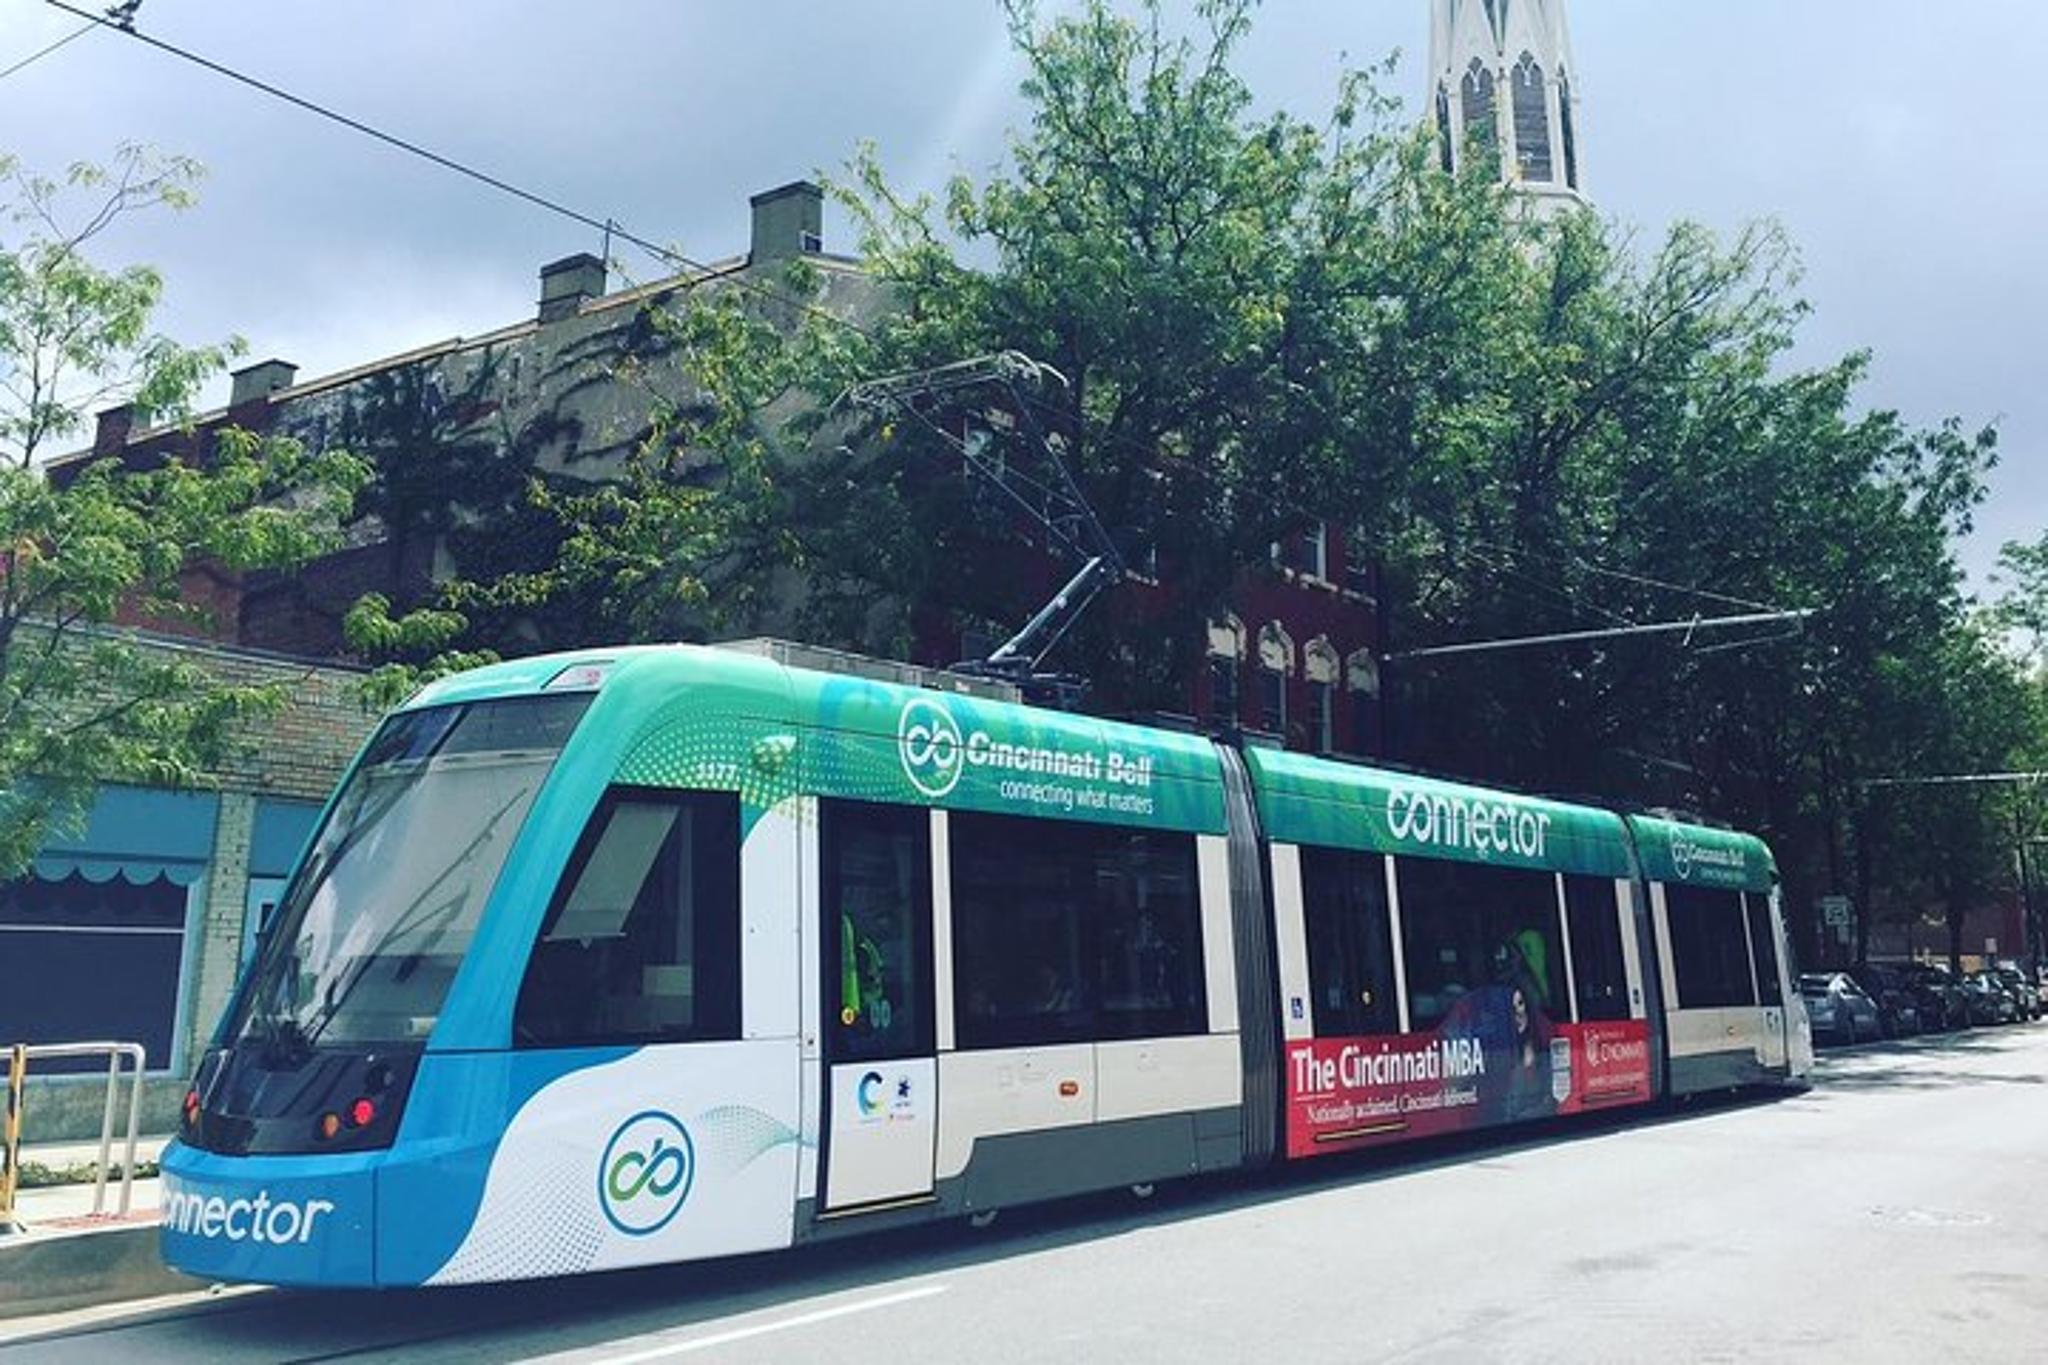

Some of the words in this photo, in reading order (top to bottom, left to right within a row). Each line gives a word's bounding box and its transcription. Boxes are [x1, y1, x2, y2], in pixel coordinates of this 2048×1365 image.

[966, 731, 1101, 778] Cincinnati
[1107, 752, 1152, 786] Bell
[1000, 778, 1073, 812] connecting
[1077, 783, 1108, 807] what
[1109, 789, 1154, 814] matters
[1293, 1046, 1335, 1092] The
[1339, 1040, 1440, 1088] Cincinnati
[1441, 1037, 1485, 1079] MBA
